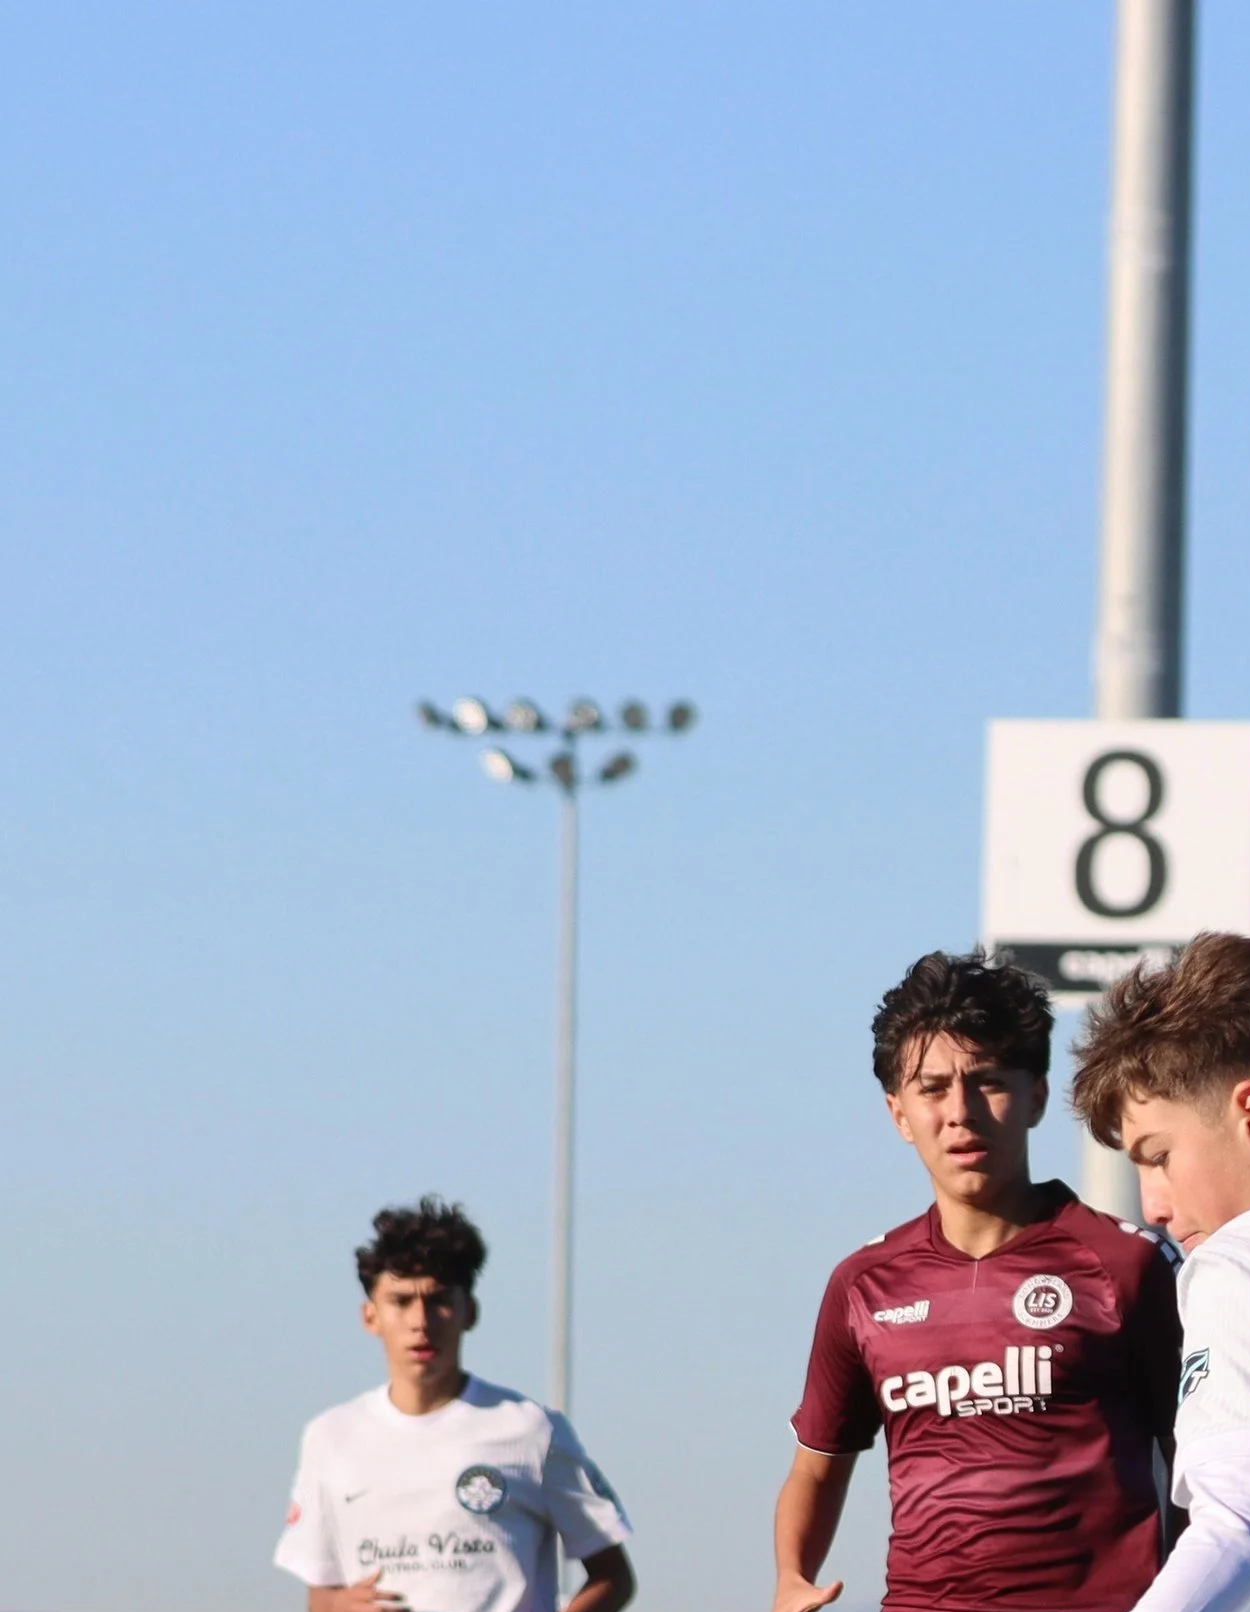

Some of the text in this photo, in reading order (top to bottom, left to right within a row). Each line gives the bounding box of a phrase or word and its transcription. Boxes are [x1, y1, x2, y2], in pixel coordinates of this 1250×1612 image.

[1075, 751, 1167, 917] 8
[874, 1299, 931, 1325] capelli
[1028, 1291, 1057, 1308] LIS
[881, 1346, 1053, 1417] capelli
[358, 1530, 497, 1566] Chula Vista
